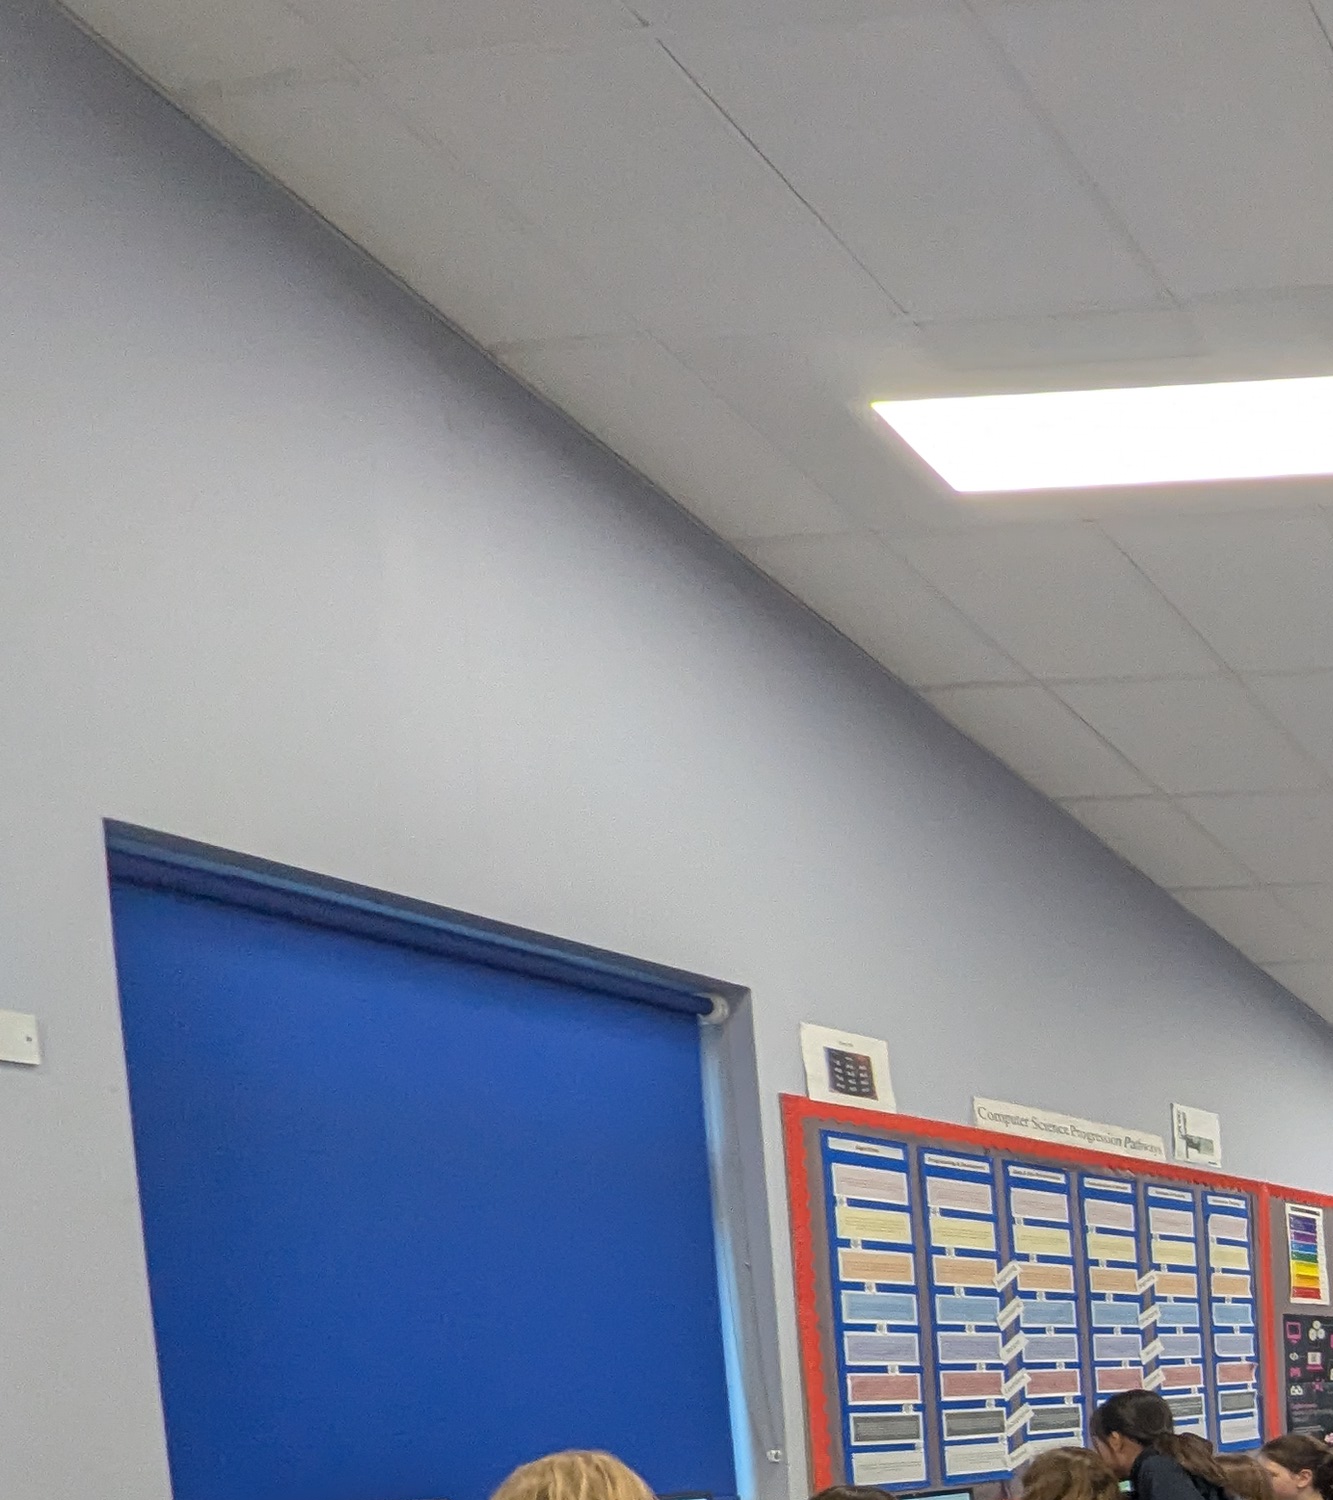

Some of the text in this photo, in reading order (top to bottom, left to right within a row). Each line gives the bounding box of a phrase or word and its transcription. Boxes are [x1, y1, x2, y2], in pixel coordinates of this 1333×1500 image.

[978, 1107, 1163, 1157] Computer Science Progression Pathways
